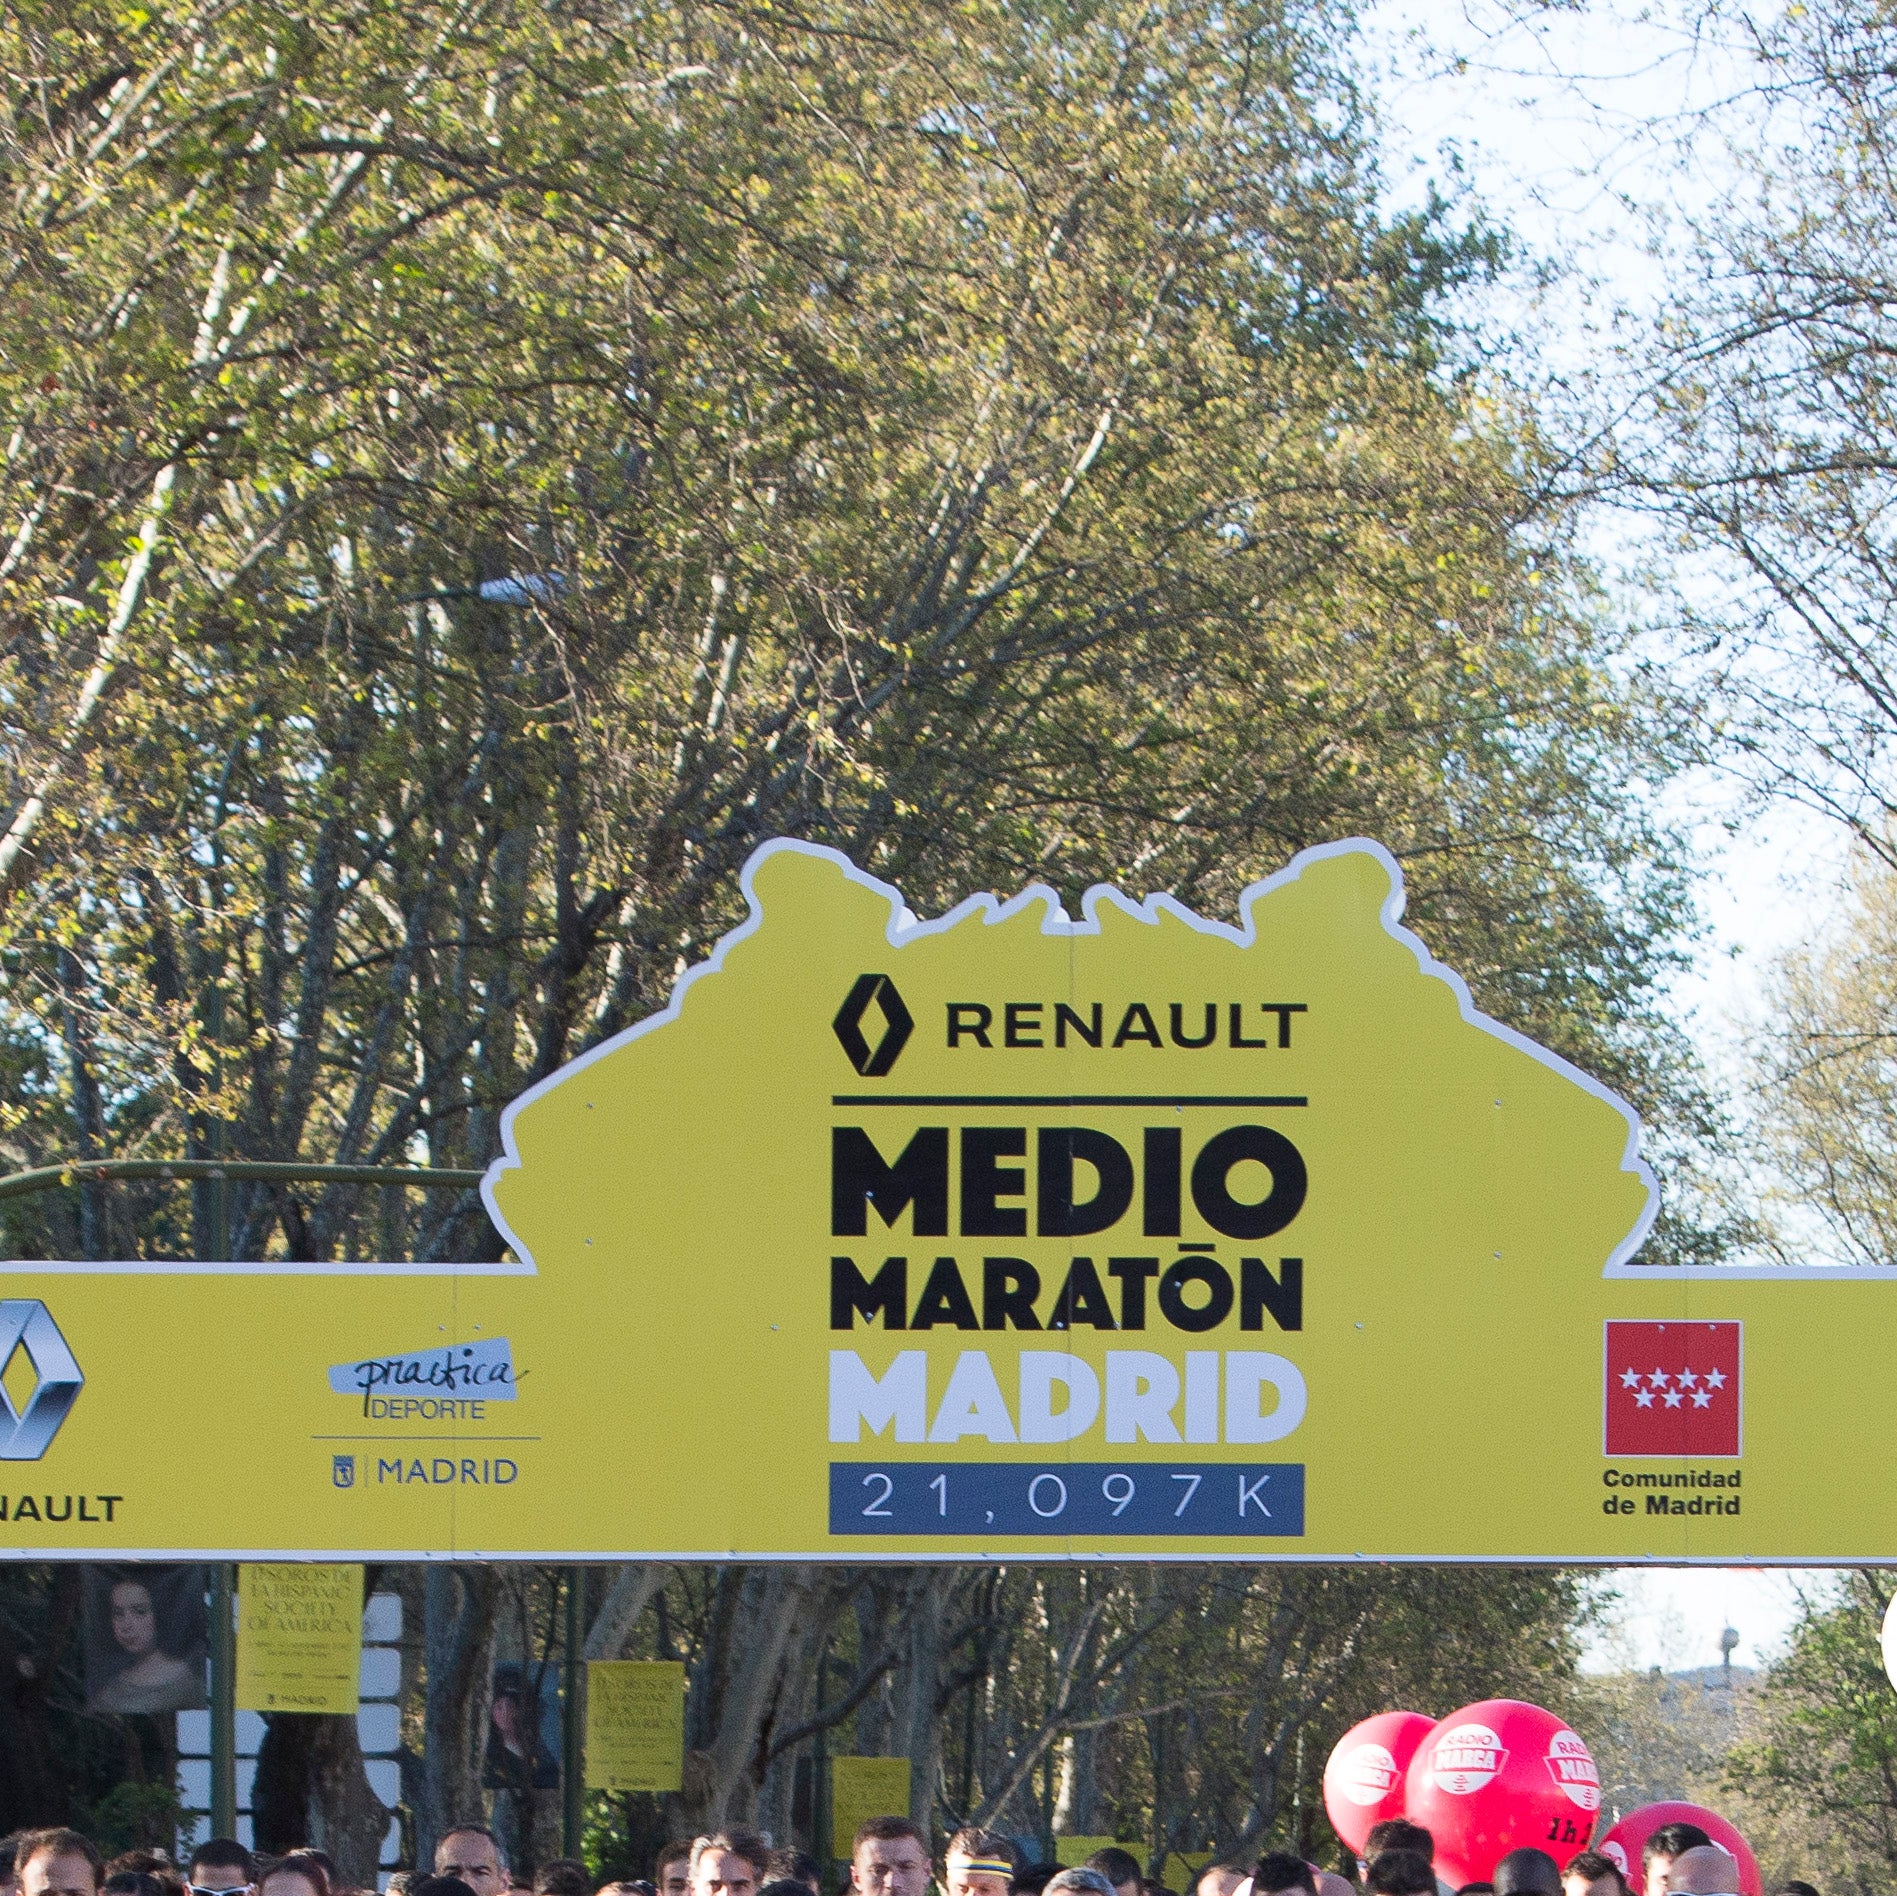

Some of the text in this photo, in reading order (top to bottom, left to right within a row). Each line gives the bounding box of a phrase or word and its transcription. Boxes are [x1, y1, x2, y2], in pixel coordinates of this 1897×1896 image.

[946, 1003, 1308, 1048] RENAULT
[831, 1125, 1308, 1241] MEDIO
[371, 1399, 485, 1420] DEPORTE
[828, 1349, 1308, 1444] MADRID
[377, 1459, 518, 1484] MADRID
[1603, 1469, 1741, 1488] Comunidad
[861, 1473, 1272, 1524] 21,097K
[1603, 1495, 1741, 1516] de Madrid
